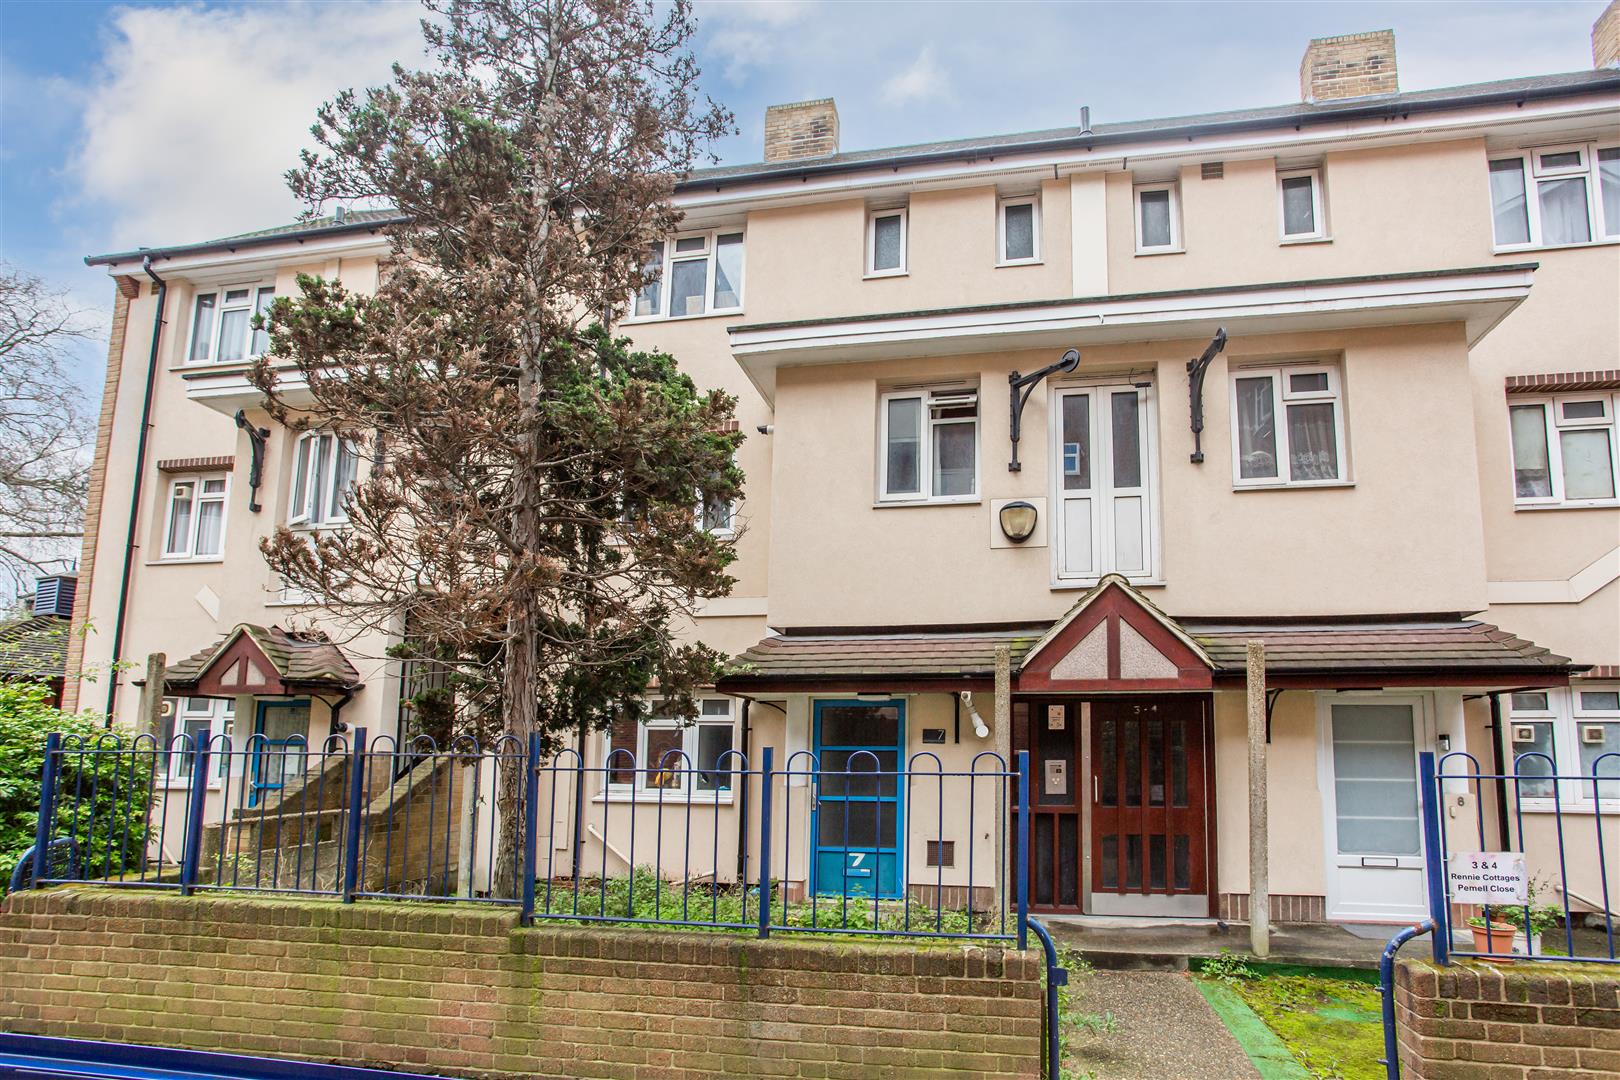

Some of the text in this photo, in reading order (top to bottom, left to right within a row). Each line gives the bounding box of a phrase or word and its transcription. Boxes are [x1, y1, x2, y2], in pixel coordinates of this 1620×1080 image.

[938, 729, 945, 740] 7
[1457, 796, 1465, 806] 8
[848, 852, 866, 867] 7
[1471, 861, 1498, 869] 3 & 4
[1450, 873, 1520, 882] Rennie Cottages
